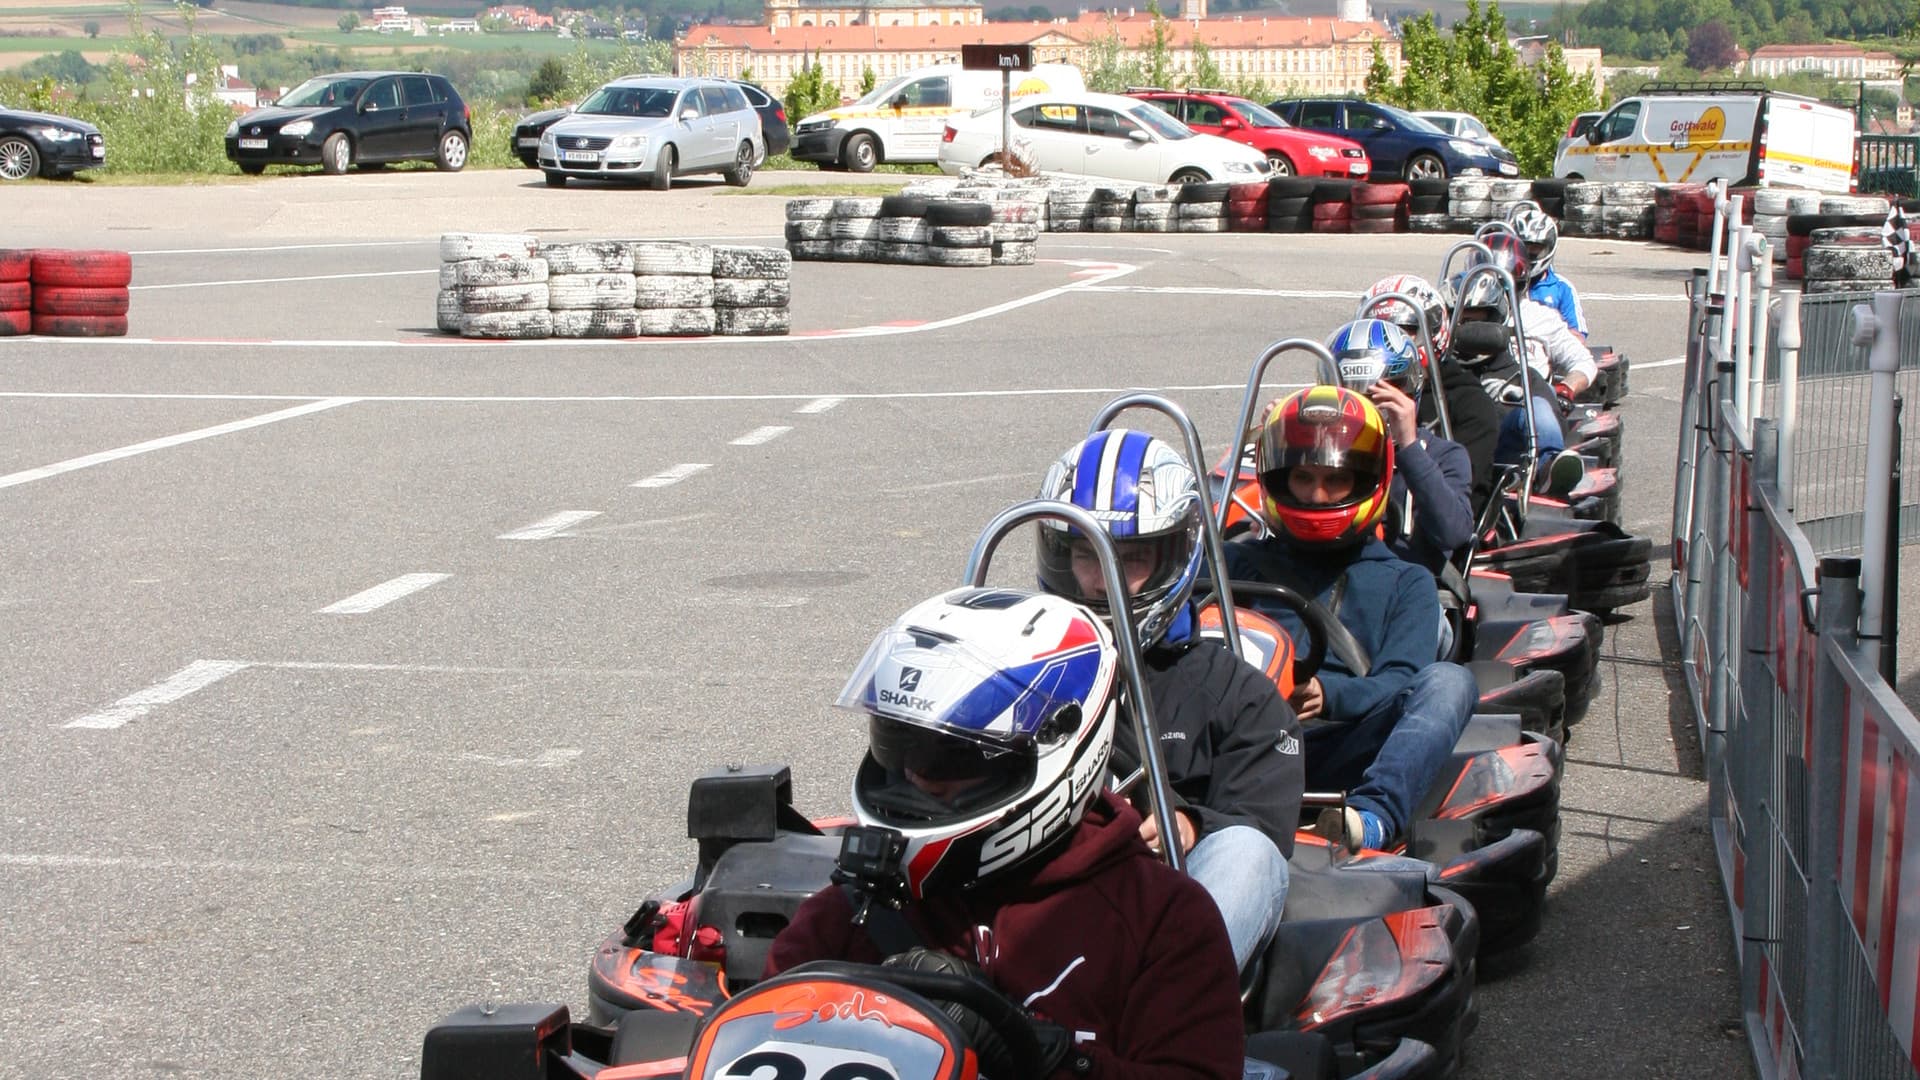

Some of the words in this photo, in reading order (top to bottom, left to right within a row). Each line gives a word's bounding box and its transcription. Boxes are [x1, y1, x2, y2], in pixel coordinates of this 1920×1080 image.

[998, 54, 1020, 67] km/h
[1670, 120, 1718, 131] Gottwald
[1342, 365, 1374, 376] SHOEI
[879, 689, 937, 712] SHARK
[1075, 739, 1110, 794] SHARK
[773, 986, 894, 1031] Sodi
